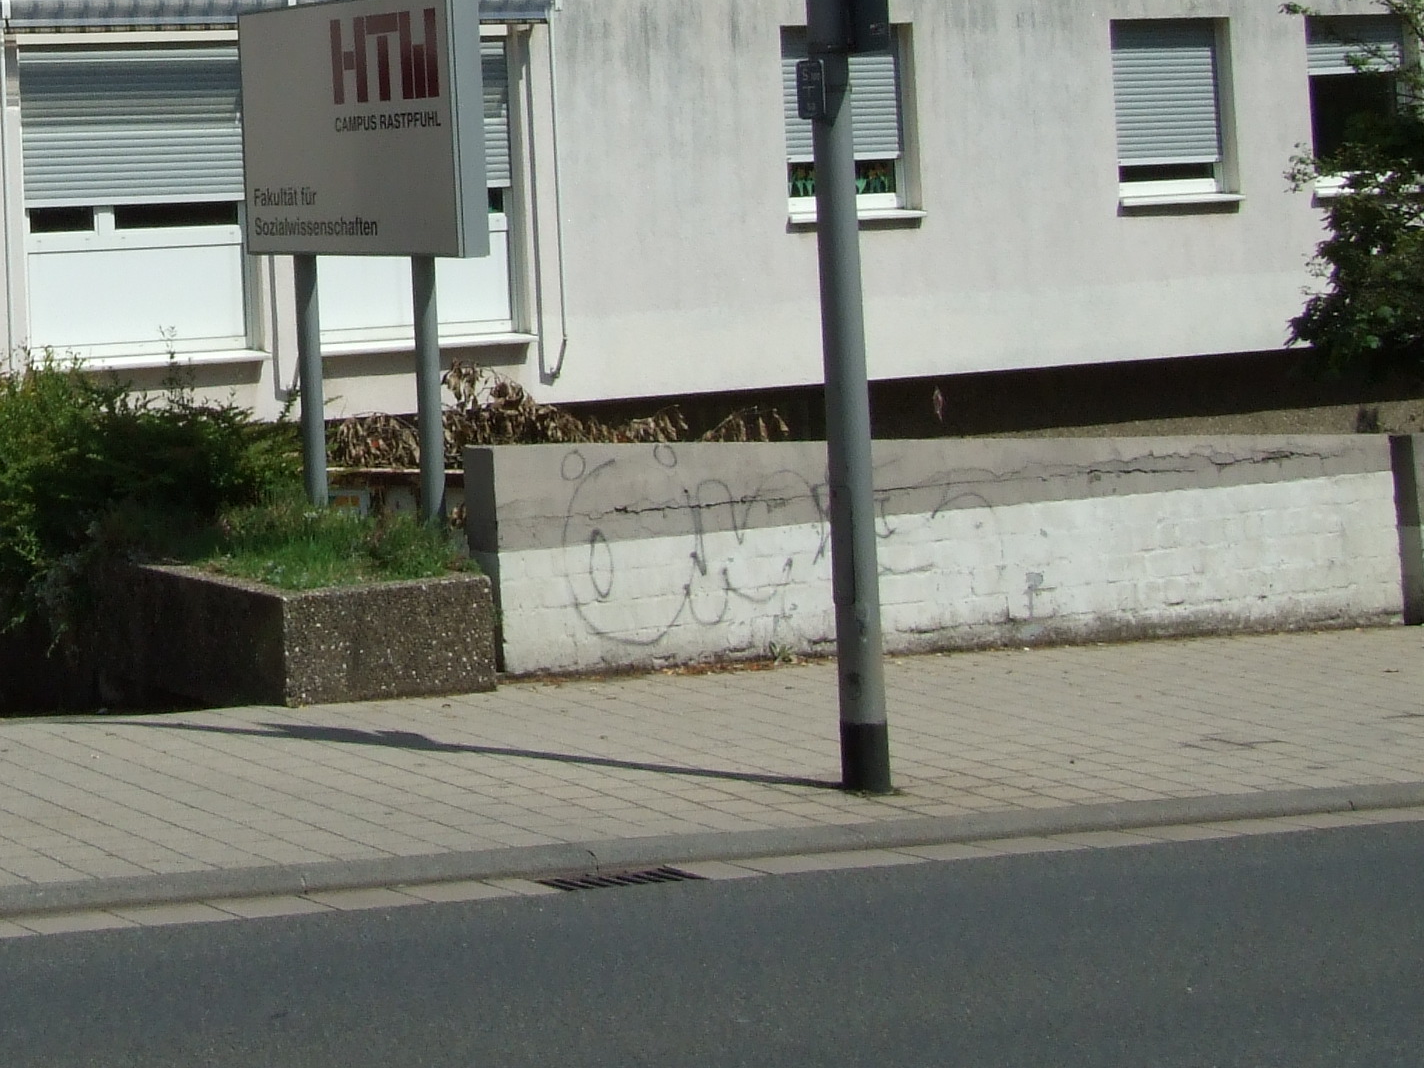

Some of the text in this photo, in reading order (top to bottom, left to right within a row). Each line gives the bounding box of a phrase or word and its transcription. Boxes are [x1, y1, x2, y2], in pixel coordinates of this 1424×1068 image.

[330, 8, 439, 104] HTW
[335, 111, 441, 132] CAMPUS RASTPFUHL
[254, 186, 317, 206] Fakultät für
[255, 217, 378, 236] Sozialwissenschaften
